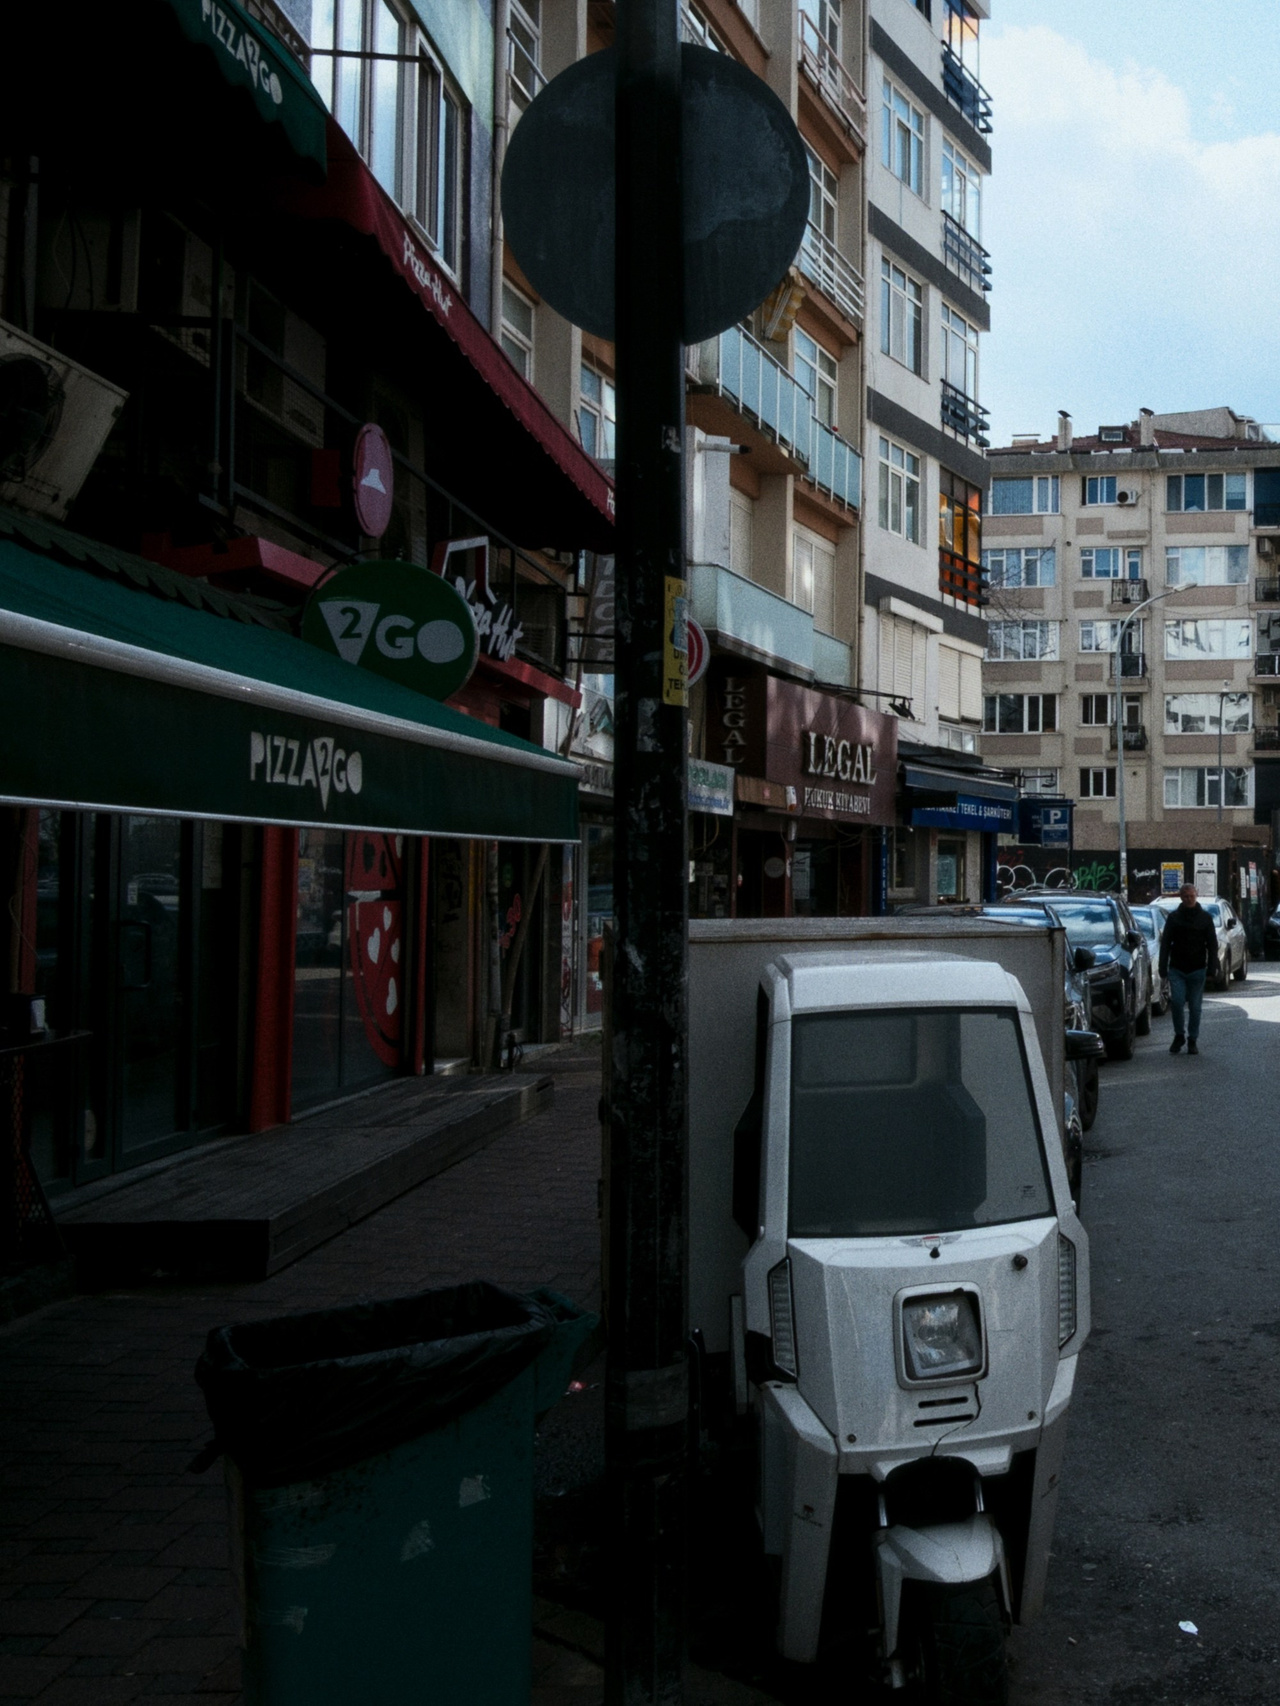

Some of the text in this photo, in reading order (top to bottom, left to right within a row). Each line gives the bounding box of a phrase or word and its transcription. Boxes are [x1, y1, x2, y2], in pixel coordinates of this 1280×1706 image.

[403, 231, 453, 317] Pizza Hut
[318, 600, 466, 665] 2GO
[721, 676, 747, 764] LEGAL
[807, 731, 878, 786] LEGAL
[249, 730, 363, 812] PIZZA2GO
